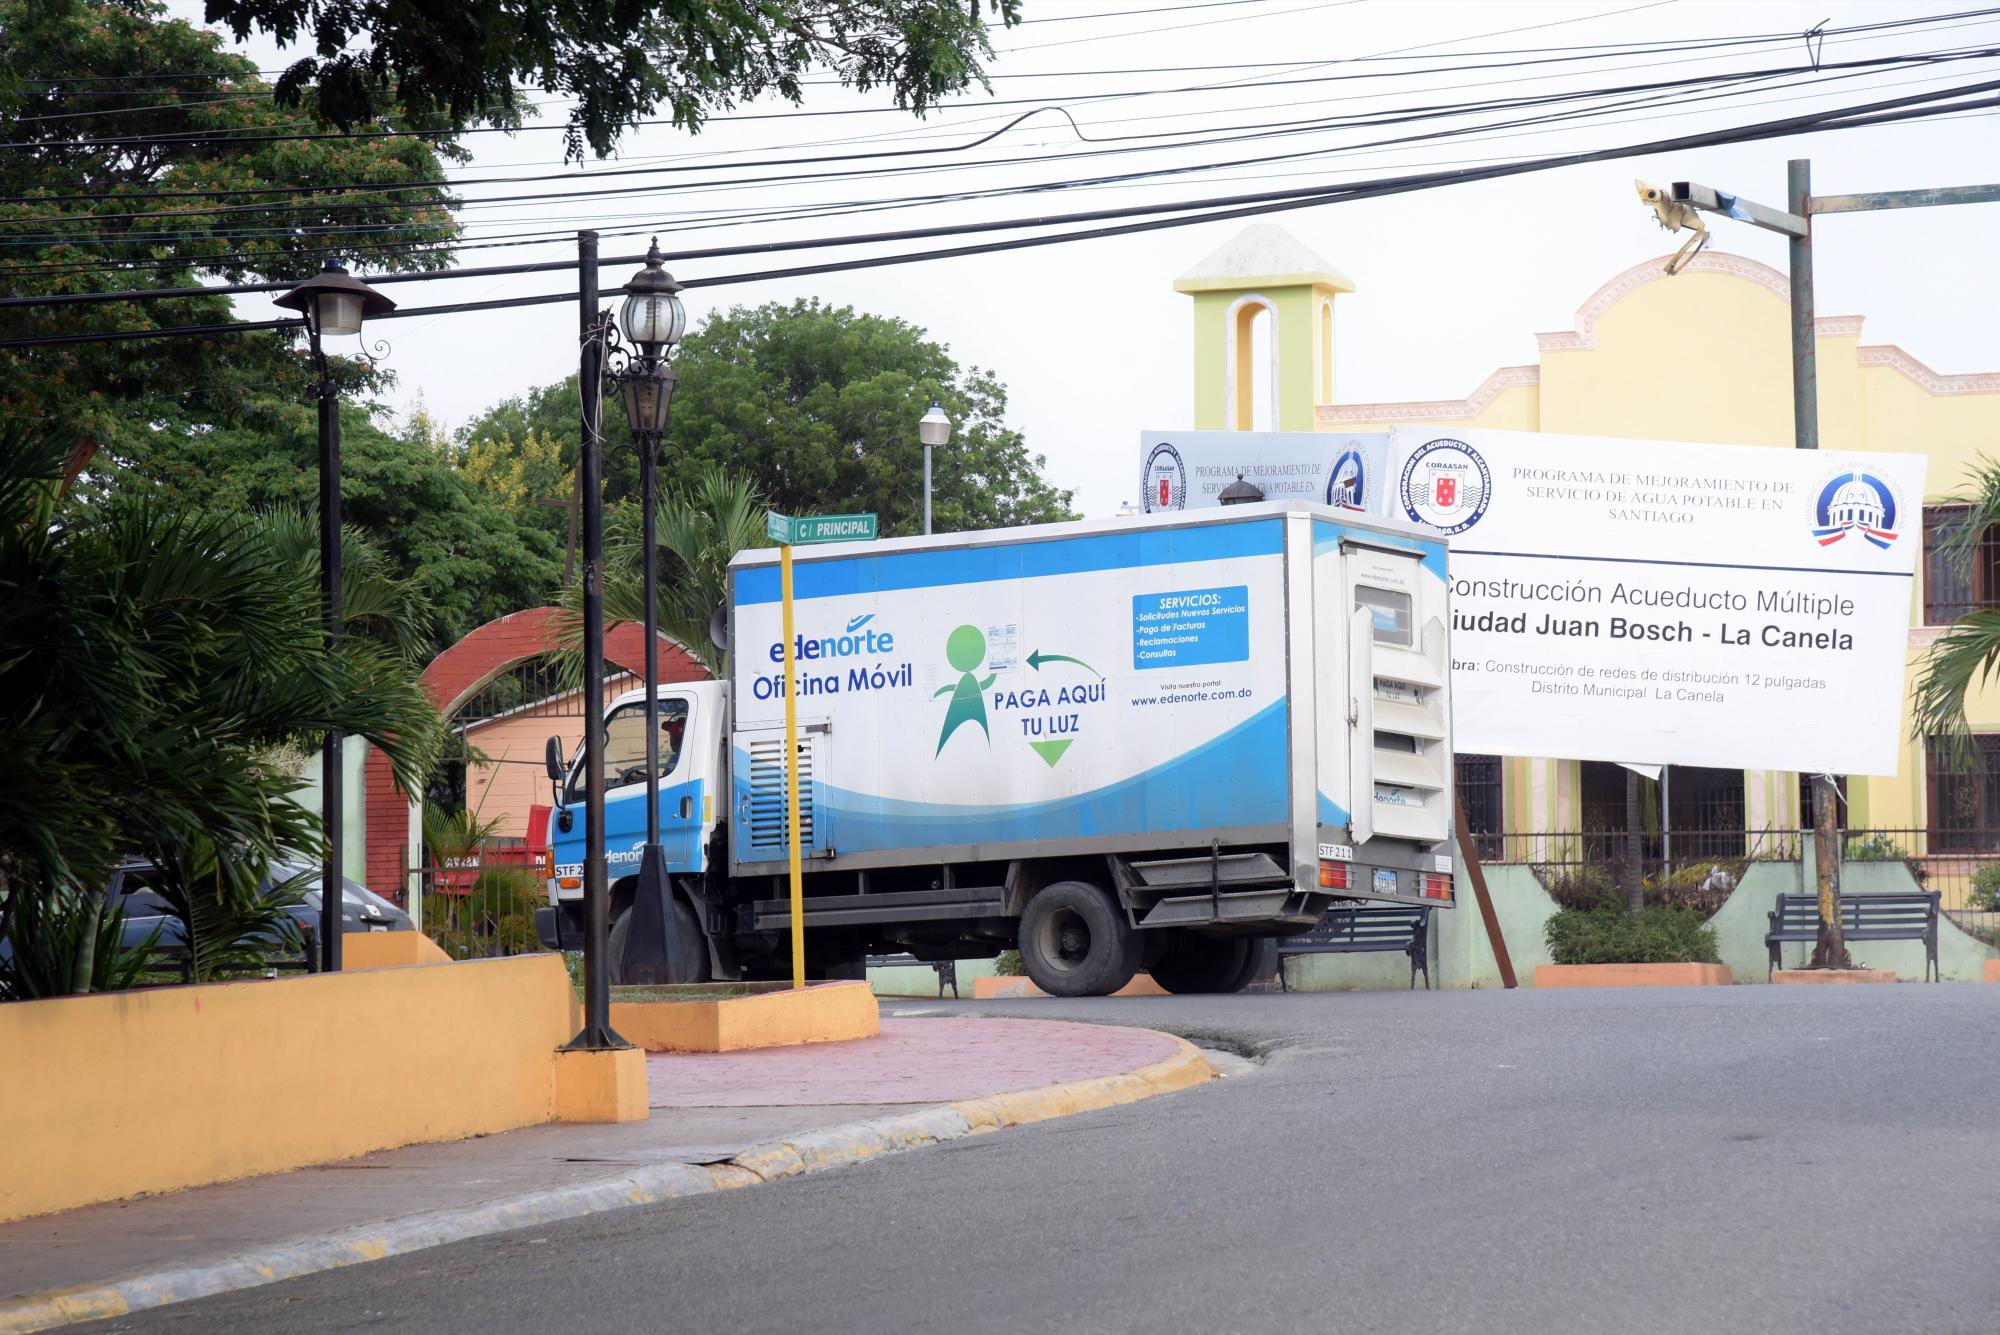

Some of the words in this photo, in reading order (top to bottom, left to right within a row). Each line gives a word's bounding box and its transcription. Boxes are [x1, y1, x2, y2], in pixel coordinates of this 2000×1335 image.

[1414, 448, 1427, 459] DEL
[1426, 440, 1466, 452] ACUEDUCTO
[1195, 465, 1239, 477] PROGRAMA
[1241, 465, 1251, 477] DE
[1253, 464, 1310, 477] MEJORAMIENTO
[1311, 463, 1321, 475] DE
[1426, 462, 1469, 470] CORAASAN
[1513, 467, 1605, 483] PROGRAMA
[1610, 472, 1631, 485] DE
[1636, 474, 1768, 492] MEJORAMIENTO
[1773, 481, 1795, 494] DE
[1526, 486, 1601, 501] SERVICIO
[1606, 490, 1626, 503] DE
[1630, 492, 1678, 505] AGUA
[1683, 495, 1756, 509] POTABLE
[1762, 498, 1783, 510] EN
[1608, 508, 1694, 524] SANTIAGO
[817, 521, 870, 536] PRINCIPAL
[1159, 593, 1221, 610] SERVICIOS:
[1610, 583, 1747, 611] Acueducto
[1757, 589, 1854, 620] Múltiple
[1136, 609, 1179, 622] -Solicitudes
[1181, 608, 1210, 618] Nuevos
[1211, 604, 1245, 615] Servicios
[1136, 626, 1159, 635] -Pago
[1161, 623, 1171, 632] de
[1172, 621, 1206, 631] Facturas
[1452, 609, 1527, 634] iudad
[1535, 613, 1600, 638] Juan
[1610, 617, 1693, 642] Bosch
[1720, 623, 1751, 646] La
[1761, 625, 1854, 651] Canela
[769, 629, 894, 663] edenorte
[1136, 635, 1199, 647] -Reclamaciones
[1136, 649, 1177, 660] -Consultas
[847, 663, 912, 692] Móvil
[1451, 658, 1480, 672] bra:
[1485, 659, 1574, 677] Construcción
[1577, 665, 1594, 678] de
[1599, 666, 1637, 680] redes
[1640, 668, 1658, 681] de
[1662, 669, 1739, 685] distribución
[1744, 673, 1760, 686] 12
[1764, 675, 1827, 691] pulgadas
[994, 688, 1051, 710] PAGA
[1057, 677, 1106, 705] AQUÍ
[1179, 681, 1201, 689] nuestro
[1531, 680, 1579, 695] Distrito
[1583, 682, 1647, 700] Municipal
[1655, 687, 1672, 700] La
[1676, 688, 1725, 703] Canela
[1131, 687, 1252, 707] www.edenorte.com.do
[1021, 717, 1042, 736] TU
[1049, 713, 1080, 734] LUZ
[1319, 845, 1334, 857] STF
[1336, 846, 1351, 859] 211
[555, 865, 575, 876] STF
